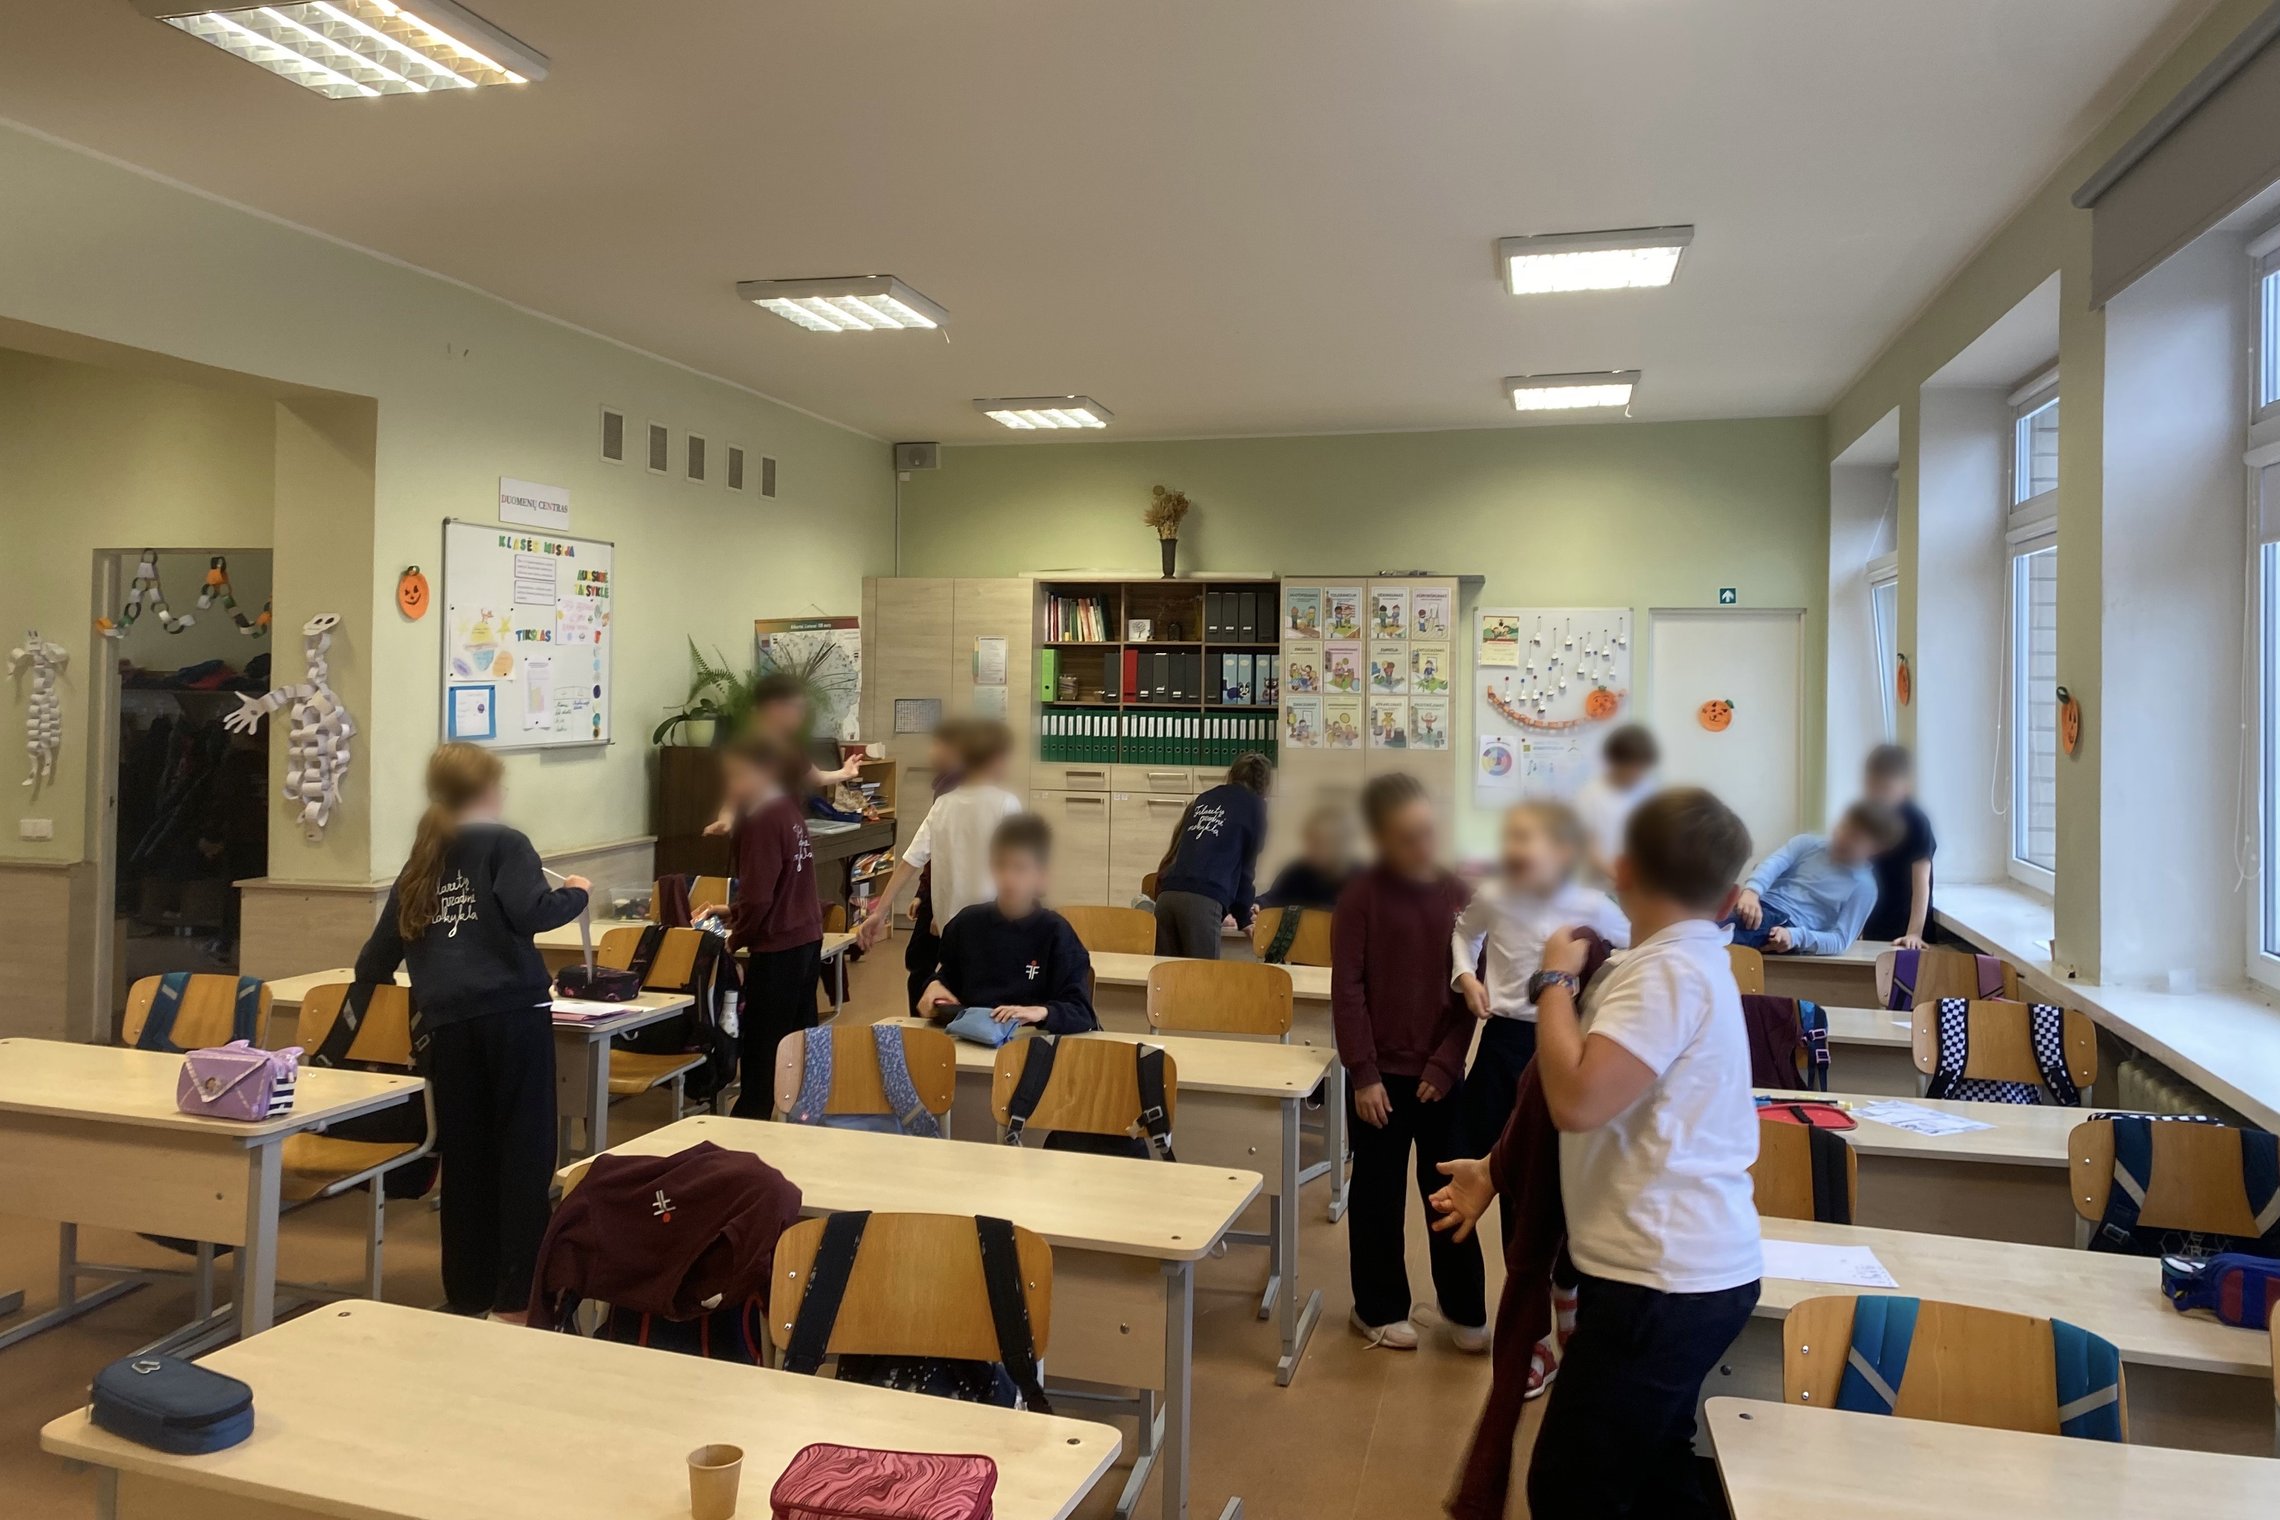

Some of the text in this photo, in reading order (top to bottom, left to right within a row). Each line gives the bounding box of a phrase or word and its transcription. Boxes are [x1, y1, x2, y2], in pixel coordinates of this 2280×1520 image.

[501, 494, 569, 513] DUOMENŲ CENTRAS
[498, 535, 575, 557] KLASĖS MISIJA
[515, 628, 552, 642] TIKSLAS
